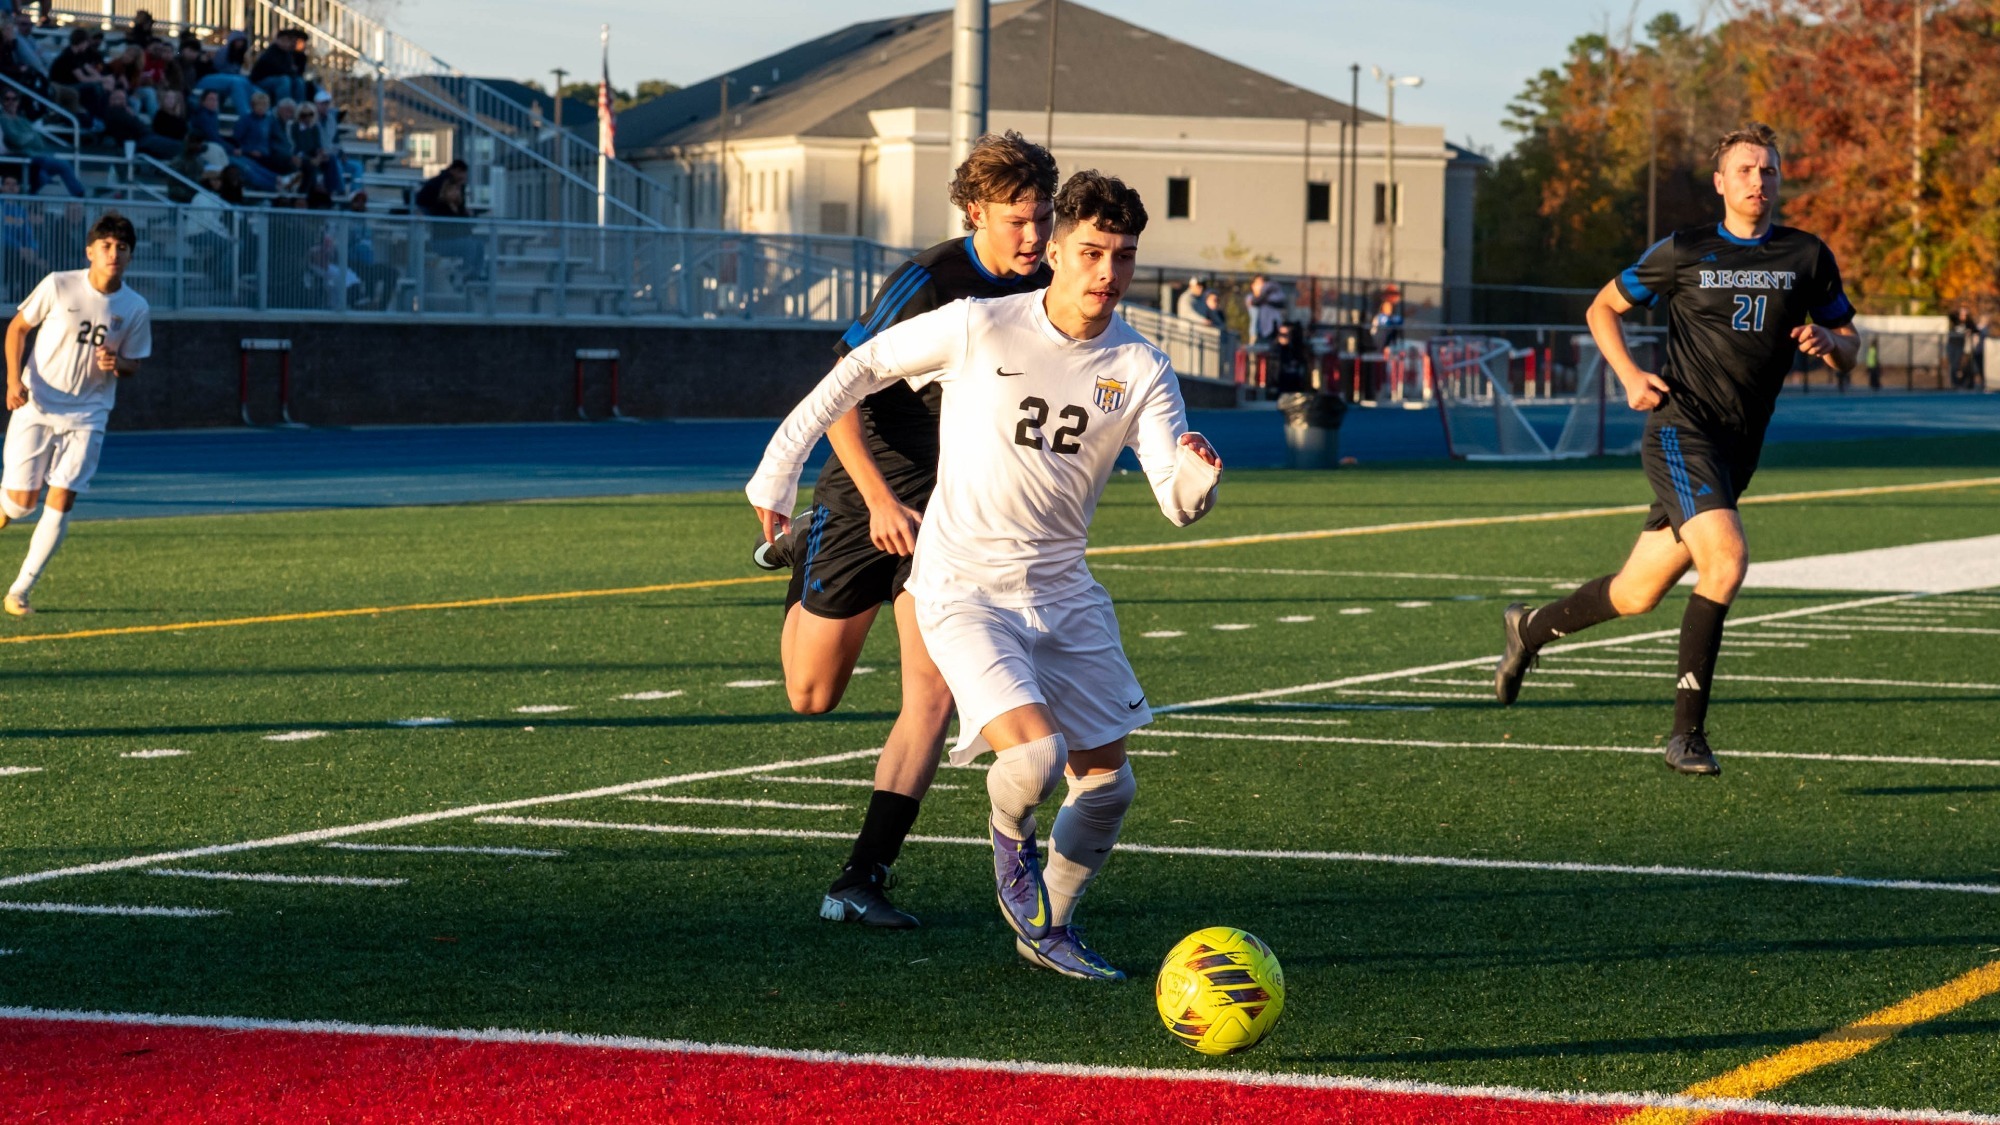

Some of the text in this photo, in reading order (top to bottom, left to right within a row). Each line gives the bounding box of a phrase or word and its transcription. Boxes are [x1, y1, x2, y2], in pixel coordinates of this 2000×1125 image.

[1699, 270, 1796, 290] REGENT
[1732, 294, 1767, 331] 21
[77, 320, 108, 347] 26
[1015, 396, 1089, 454] 22
